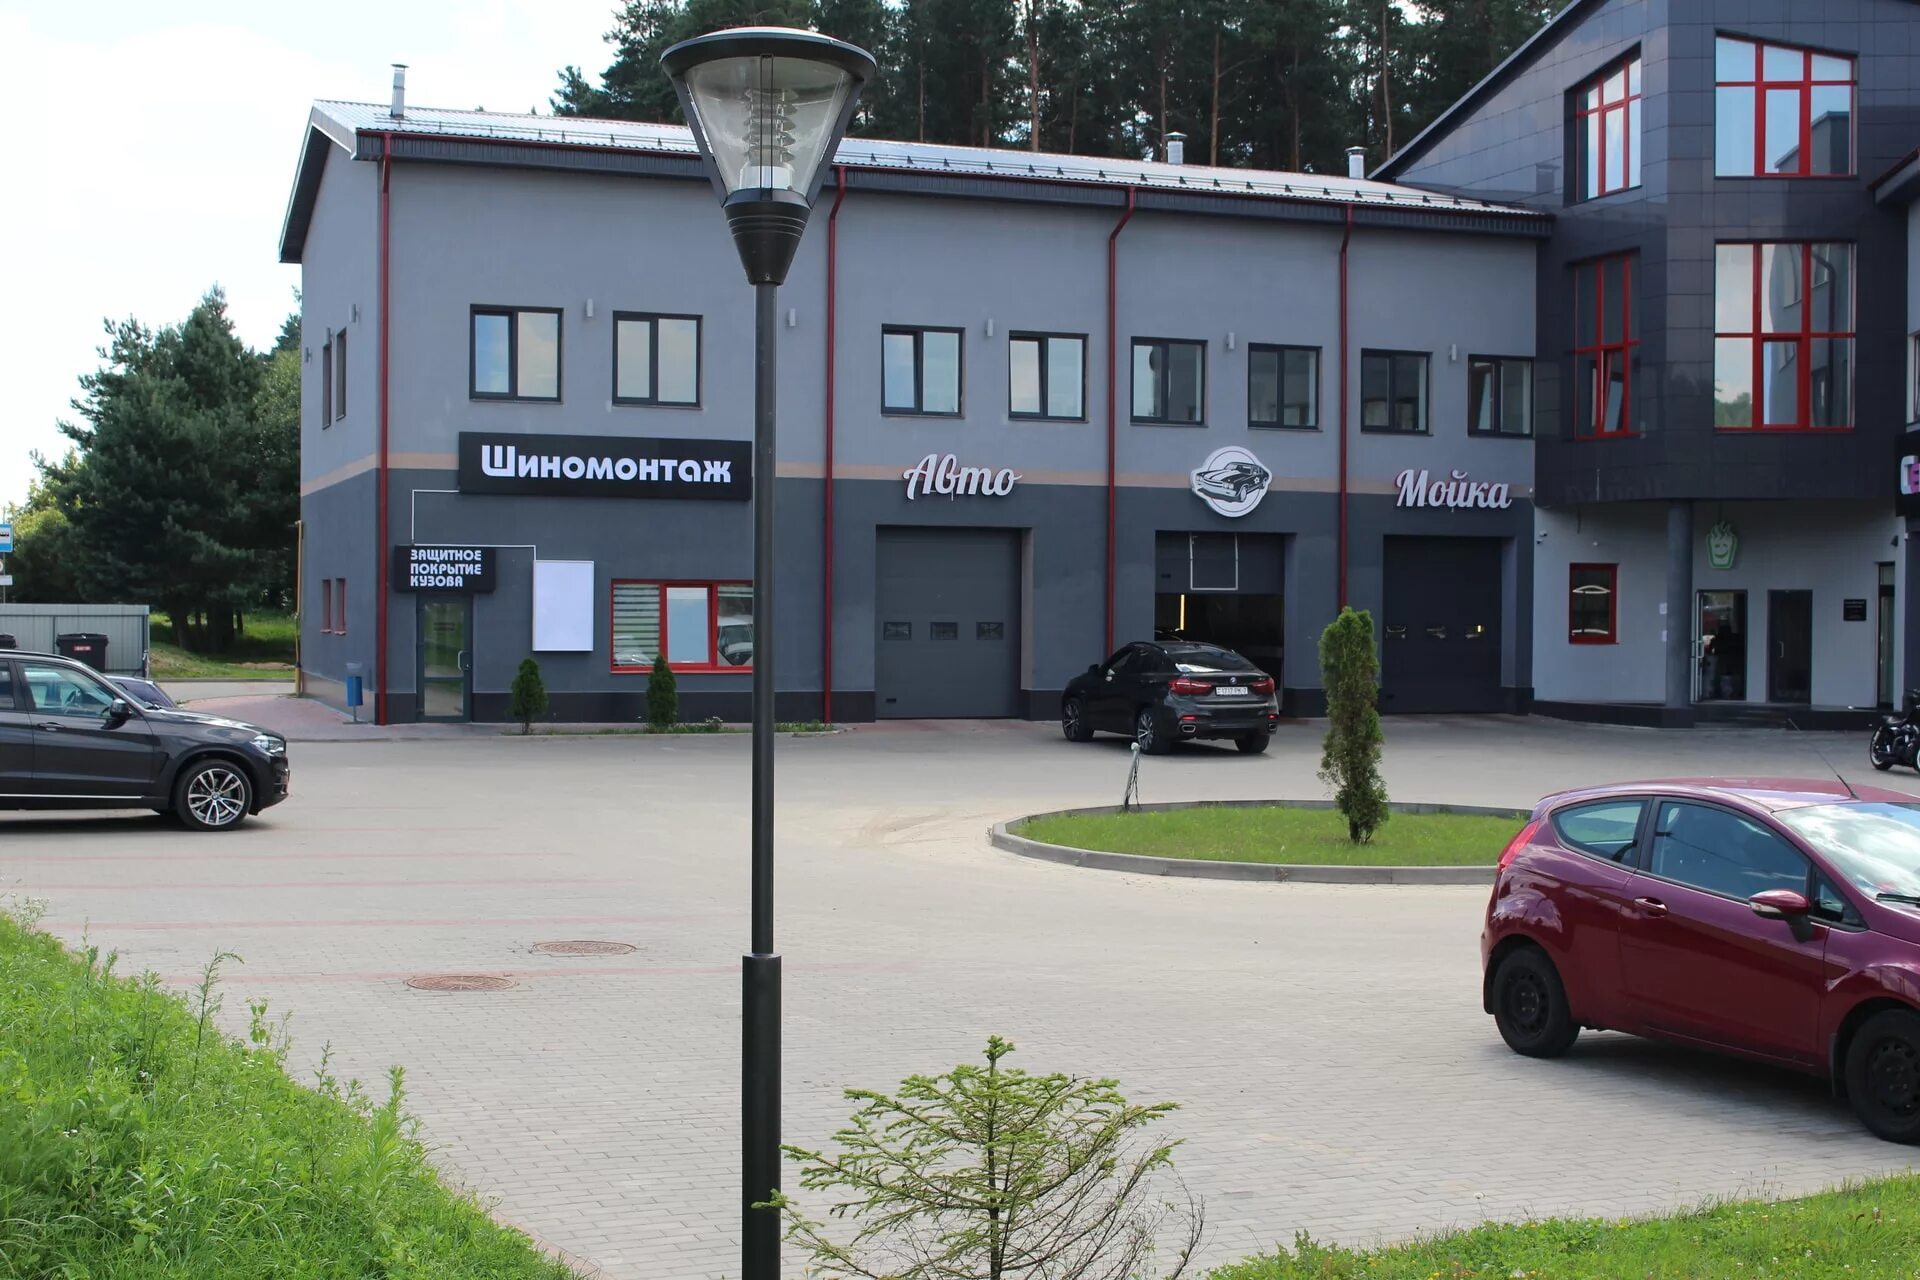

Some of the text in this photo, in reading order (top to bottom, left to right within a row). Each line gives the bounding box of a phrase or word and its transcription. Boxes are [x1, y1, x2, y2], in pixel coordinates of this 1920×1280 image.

[481, 445, 732, 483] Шиномонтаж
[903, 453, 1023, 500] Авто
[1396, 469, 1513, 509] Мойка
[410, 549, 482, 562] ЗАЩИТНОЕ
[410, 563, 482, 575] ПОКРЫТИЕ
[410, 575, 463, 587] КУЗОВА
